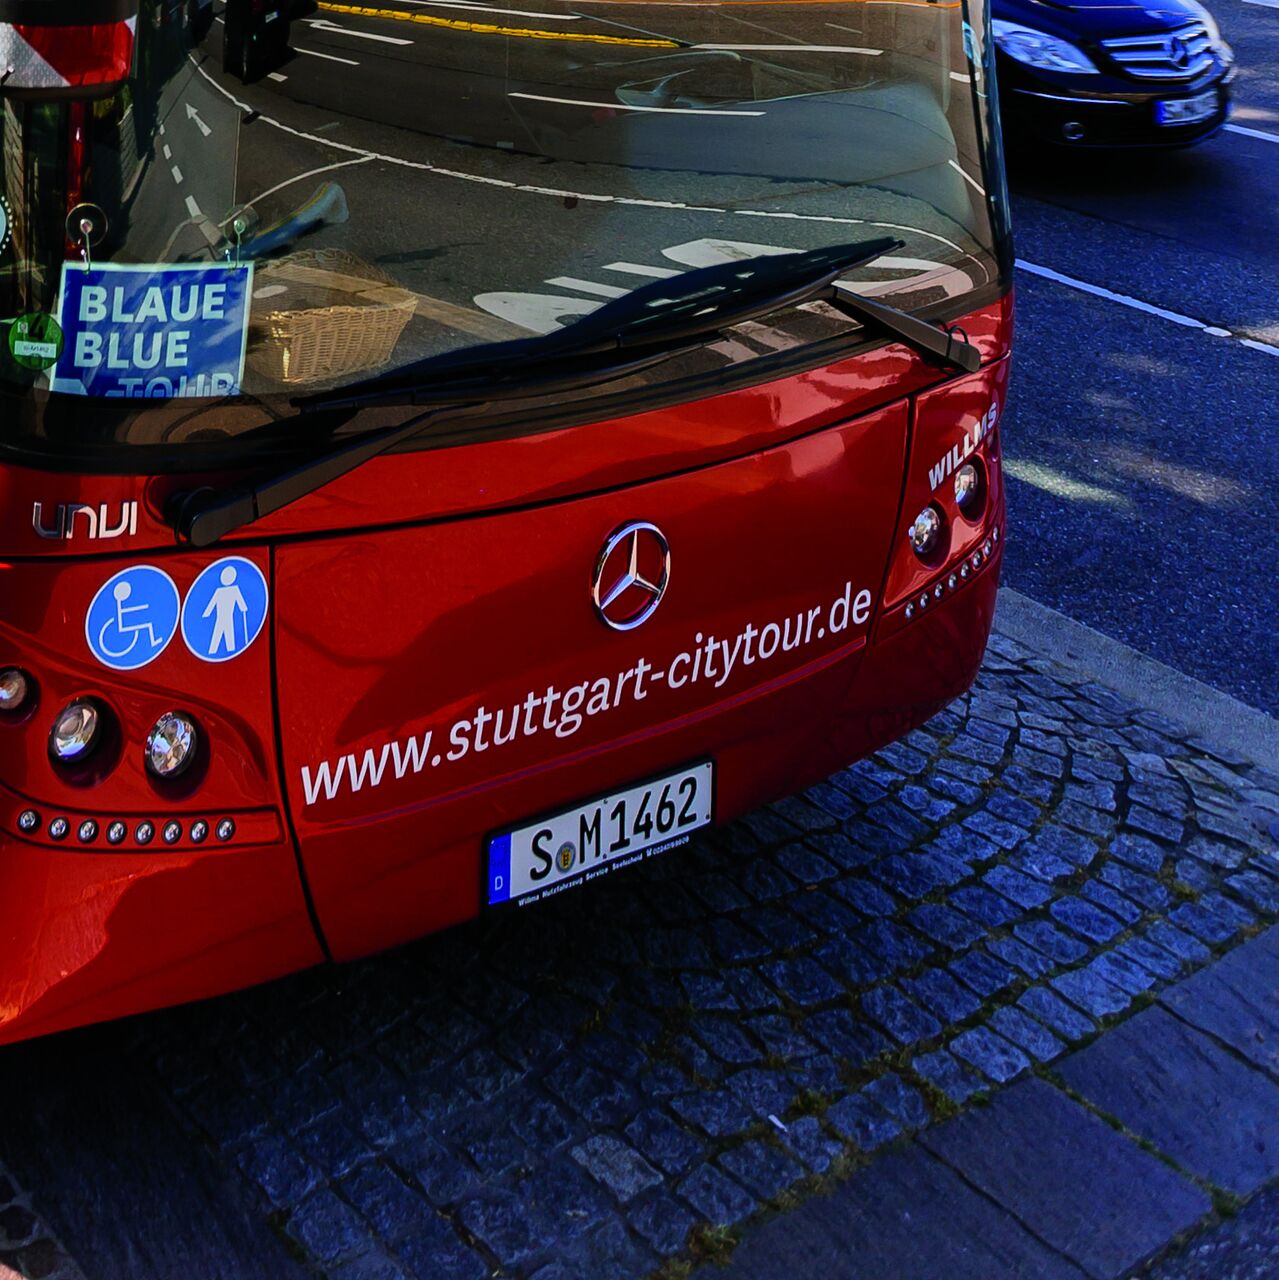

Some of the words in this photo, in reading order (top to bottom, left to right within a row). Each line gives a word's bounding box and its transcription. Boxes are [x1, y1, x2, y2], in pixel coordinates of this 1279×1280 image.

[78, 283, 227, 324] BLAUE
[73, 330, 191, 370] BLUE
[928, 401, 997, 491] WILLMS
[300, 582, 872, 806] www.stuttgart-citytour.de
[529, 828, 553, 881] S
[494, 875, 504, 891] D
